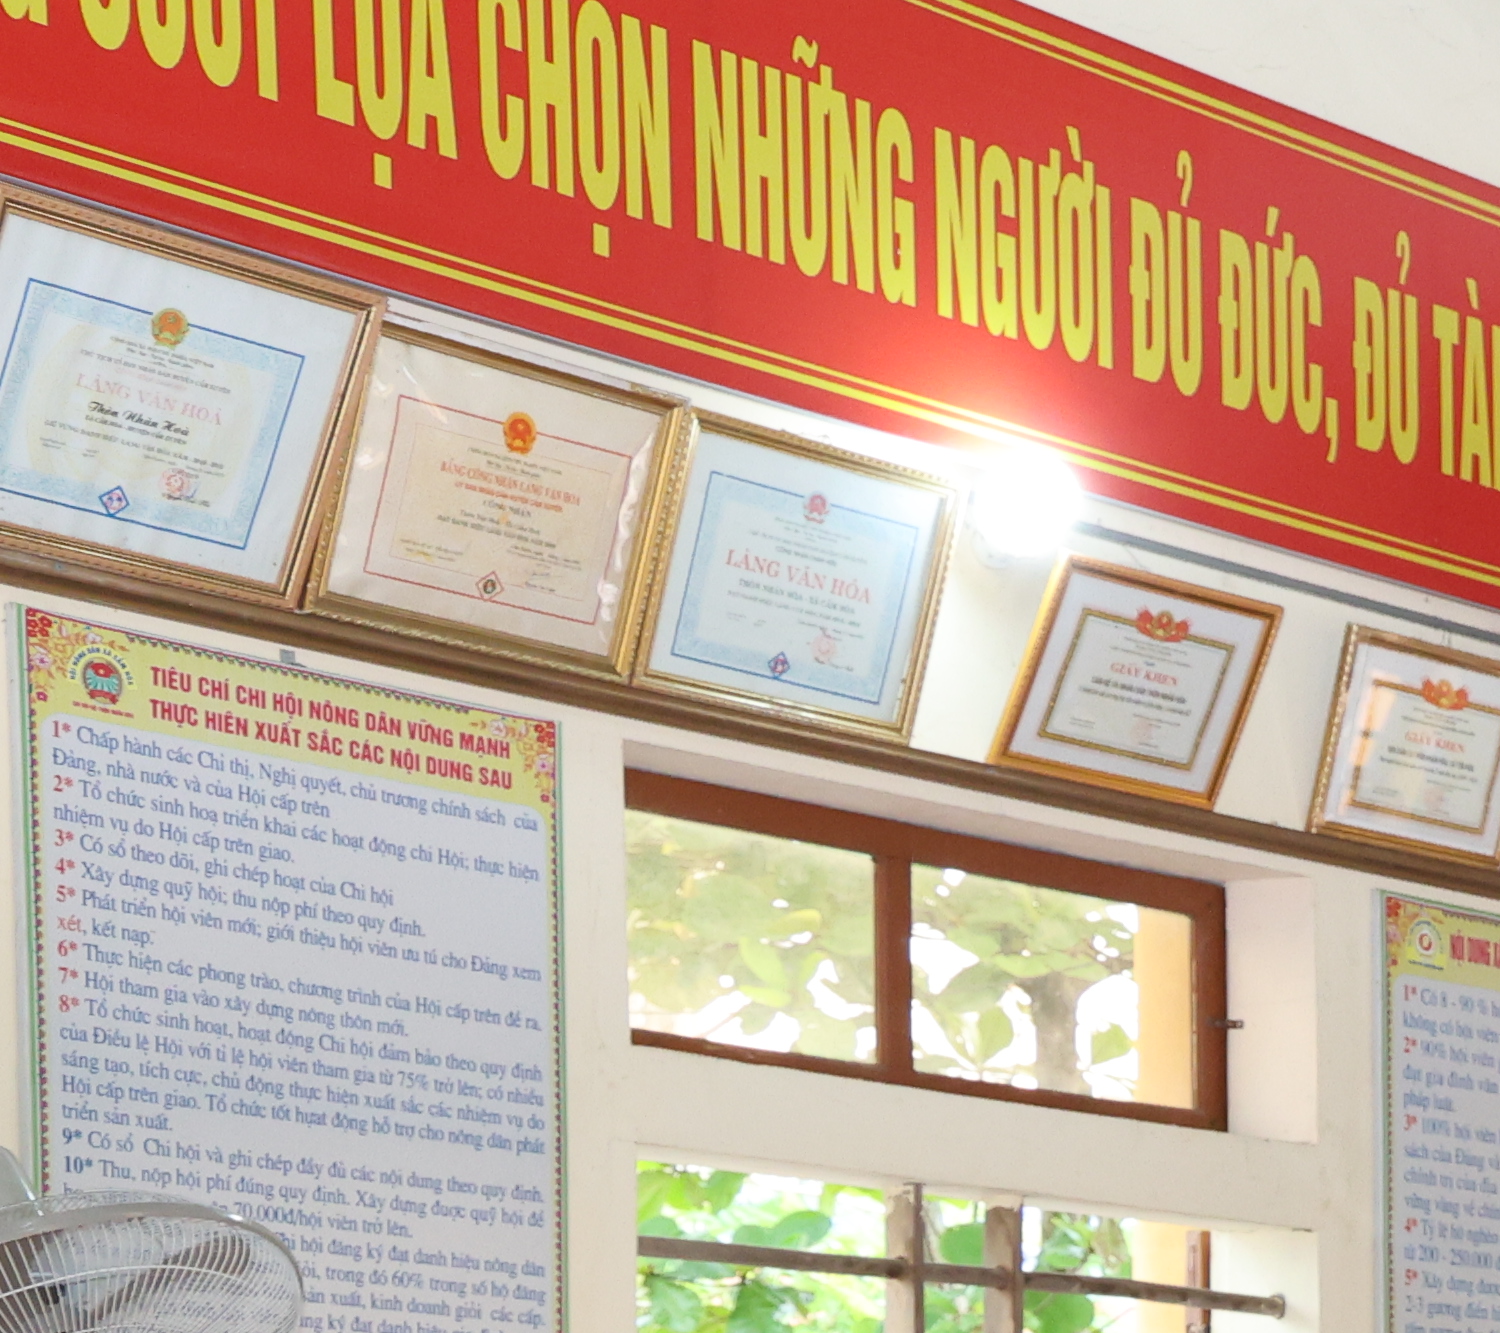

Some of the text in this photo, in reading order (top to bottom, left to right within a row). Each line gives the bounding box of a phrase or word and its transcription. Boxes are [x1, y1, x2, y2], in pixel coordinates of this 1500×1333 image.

[478, 0, 672, 256] CHỌN
[693, 36, 916, 306] NHỮNG
[935, 126, 1113, 367] NGƯỜI
[1129, 150, 1202, 395] ĐỦ
[1218, 207, 1338, 461] ĐỨC,
[1353, 232, 1418, 463] ĐỦ
[148, 697, 198, 728] THỰC
[254, 720, 301, 748] XUẤT
[348, 739, 384, 765] CÁC
[389, 748, 420, 774] NỘI
[425, 755, 474, 783] DUNG
[478, 766, 512, 790] SAU
[149, 665, 192, 692] TIÊU
[197, 675, 229, 701] CHÍ
[234, 684, 266, 709] CHI
[271, 691, 303, 718] HỘI
[308, 699, 359, 728] NÔNG
[364, 710, 402, 737] DÂN
[458, 731, 510, 759] MẠNH
